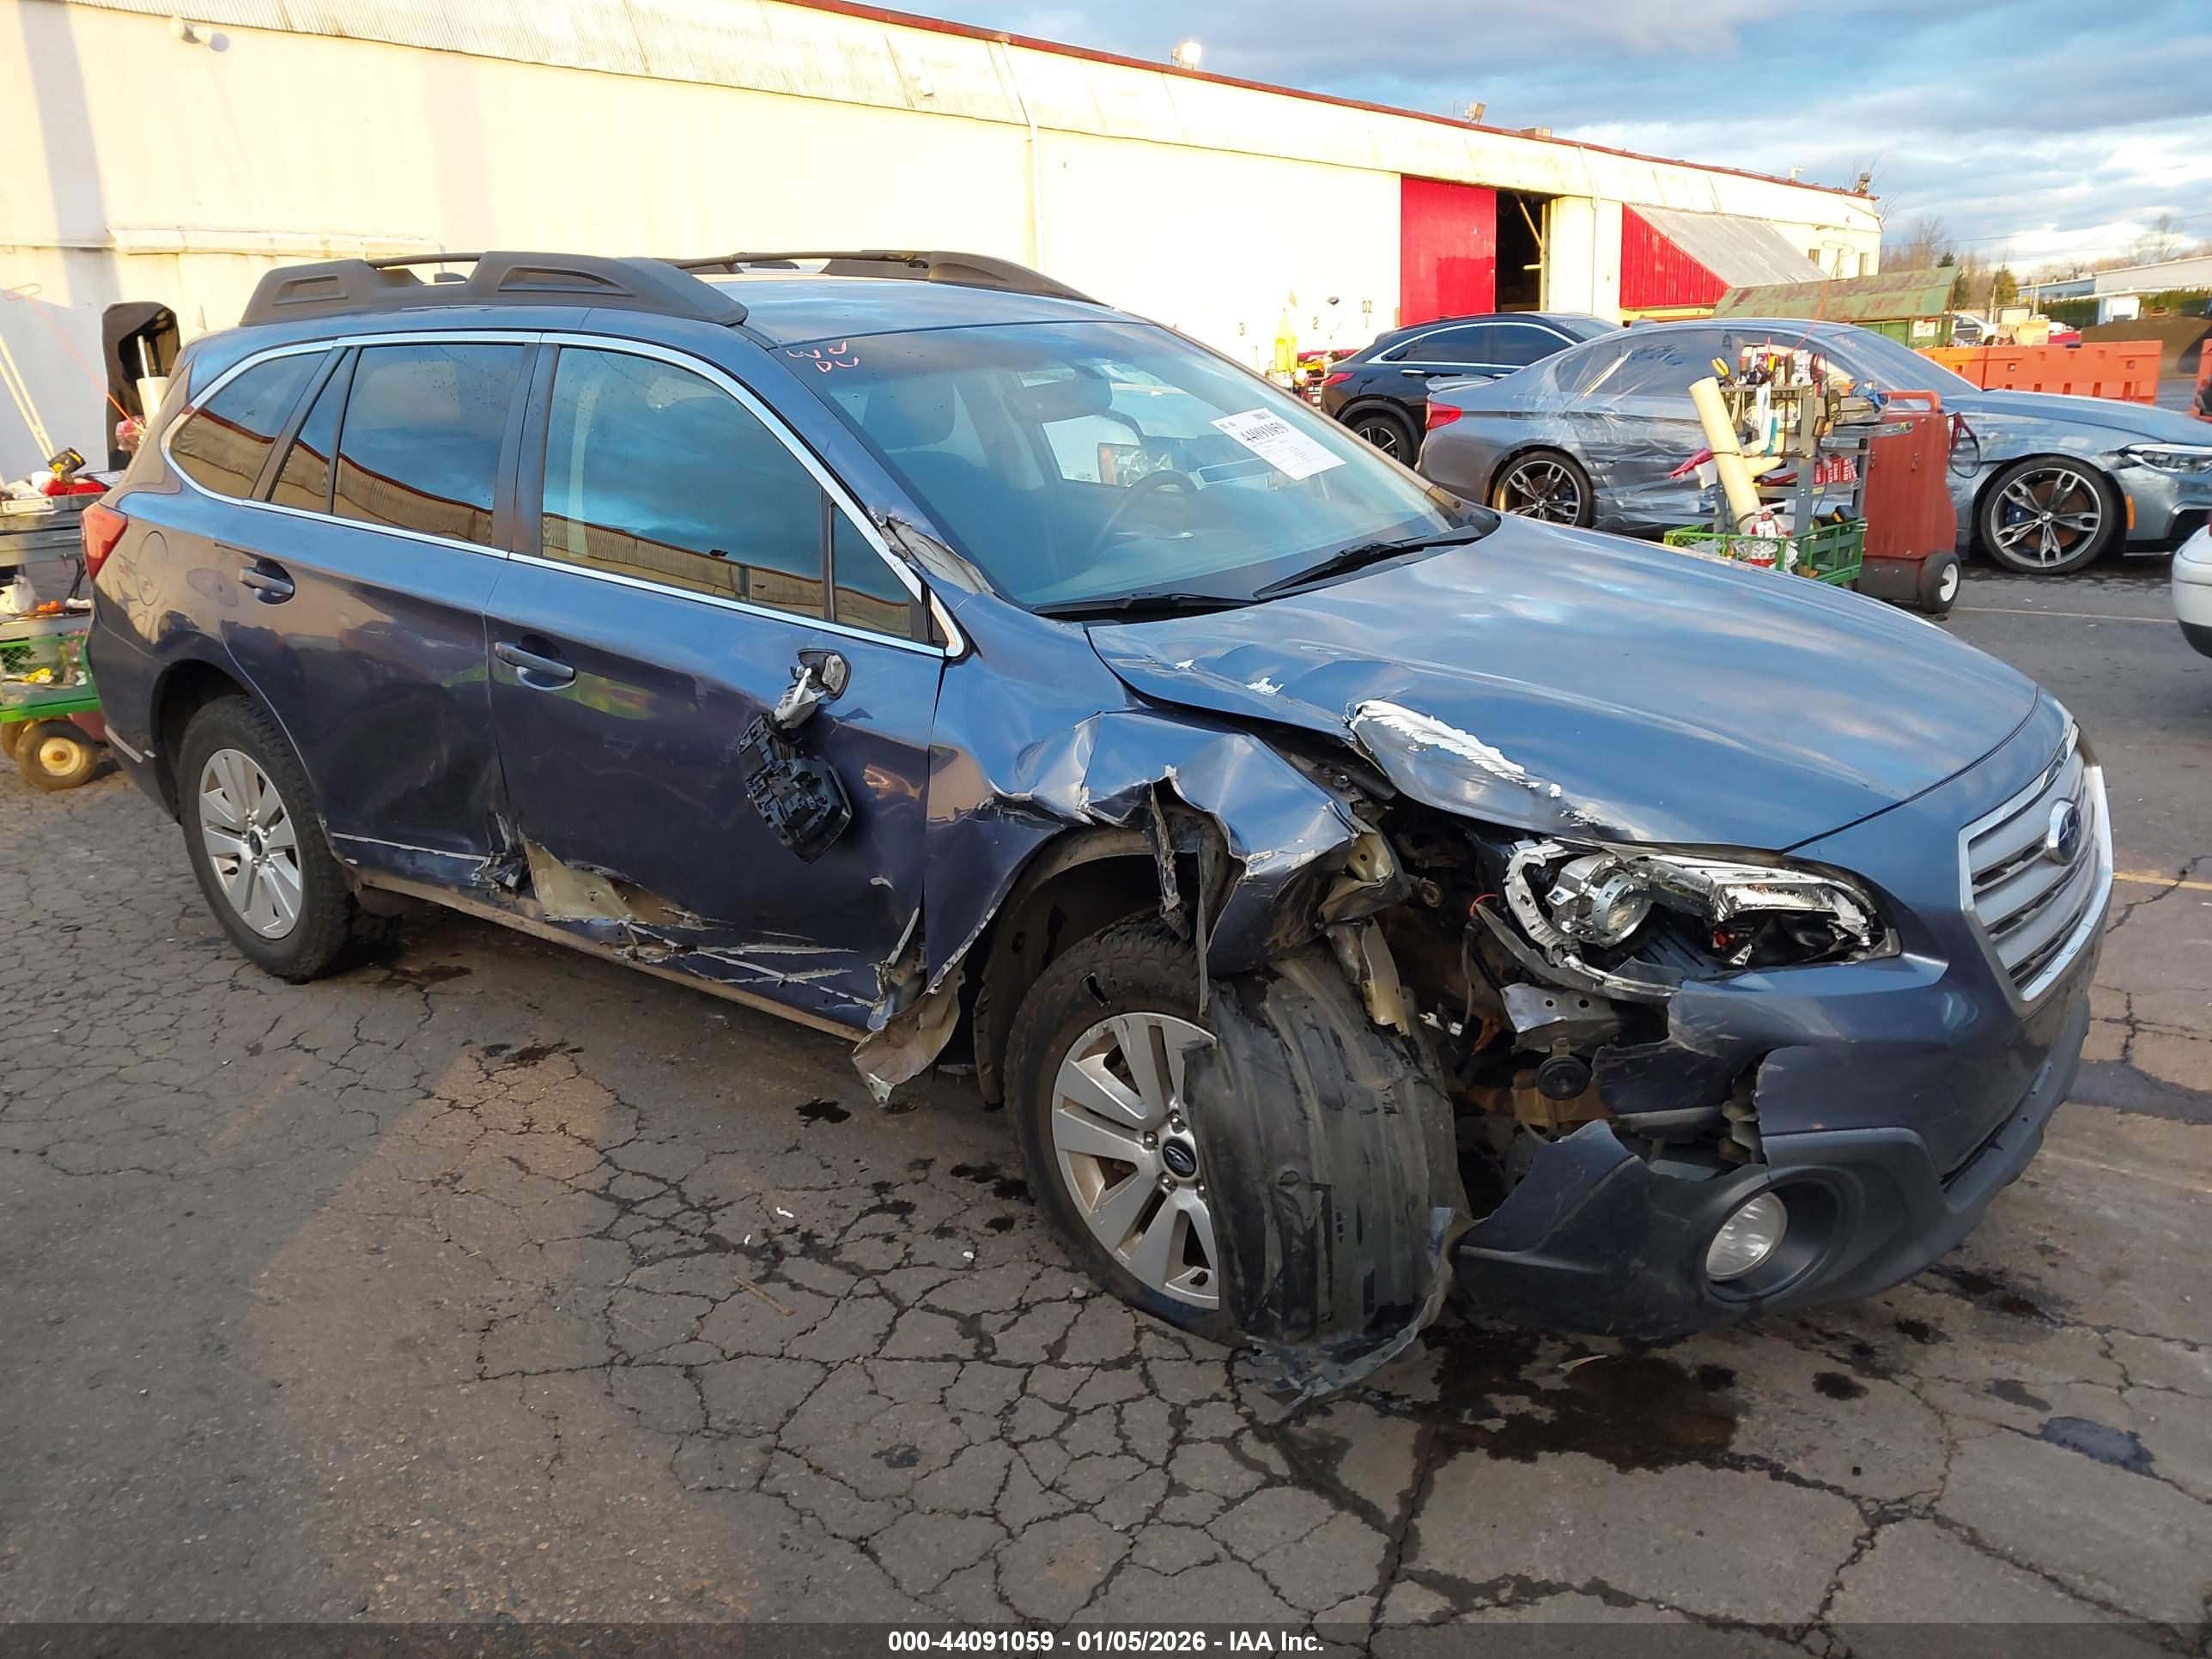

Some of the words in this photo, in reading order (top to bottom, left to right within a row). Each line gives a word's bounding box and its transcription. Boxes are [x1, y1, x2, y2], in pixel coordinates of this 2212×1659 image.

[1239, 322, 1245, 336] 3
[1313, 317, 1319, 330] 2
[1239, 422, 1289, 442] 44091059
